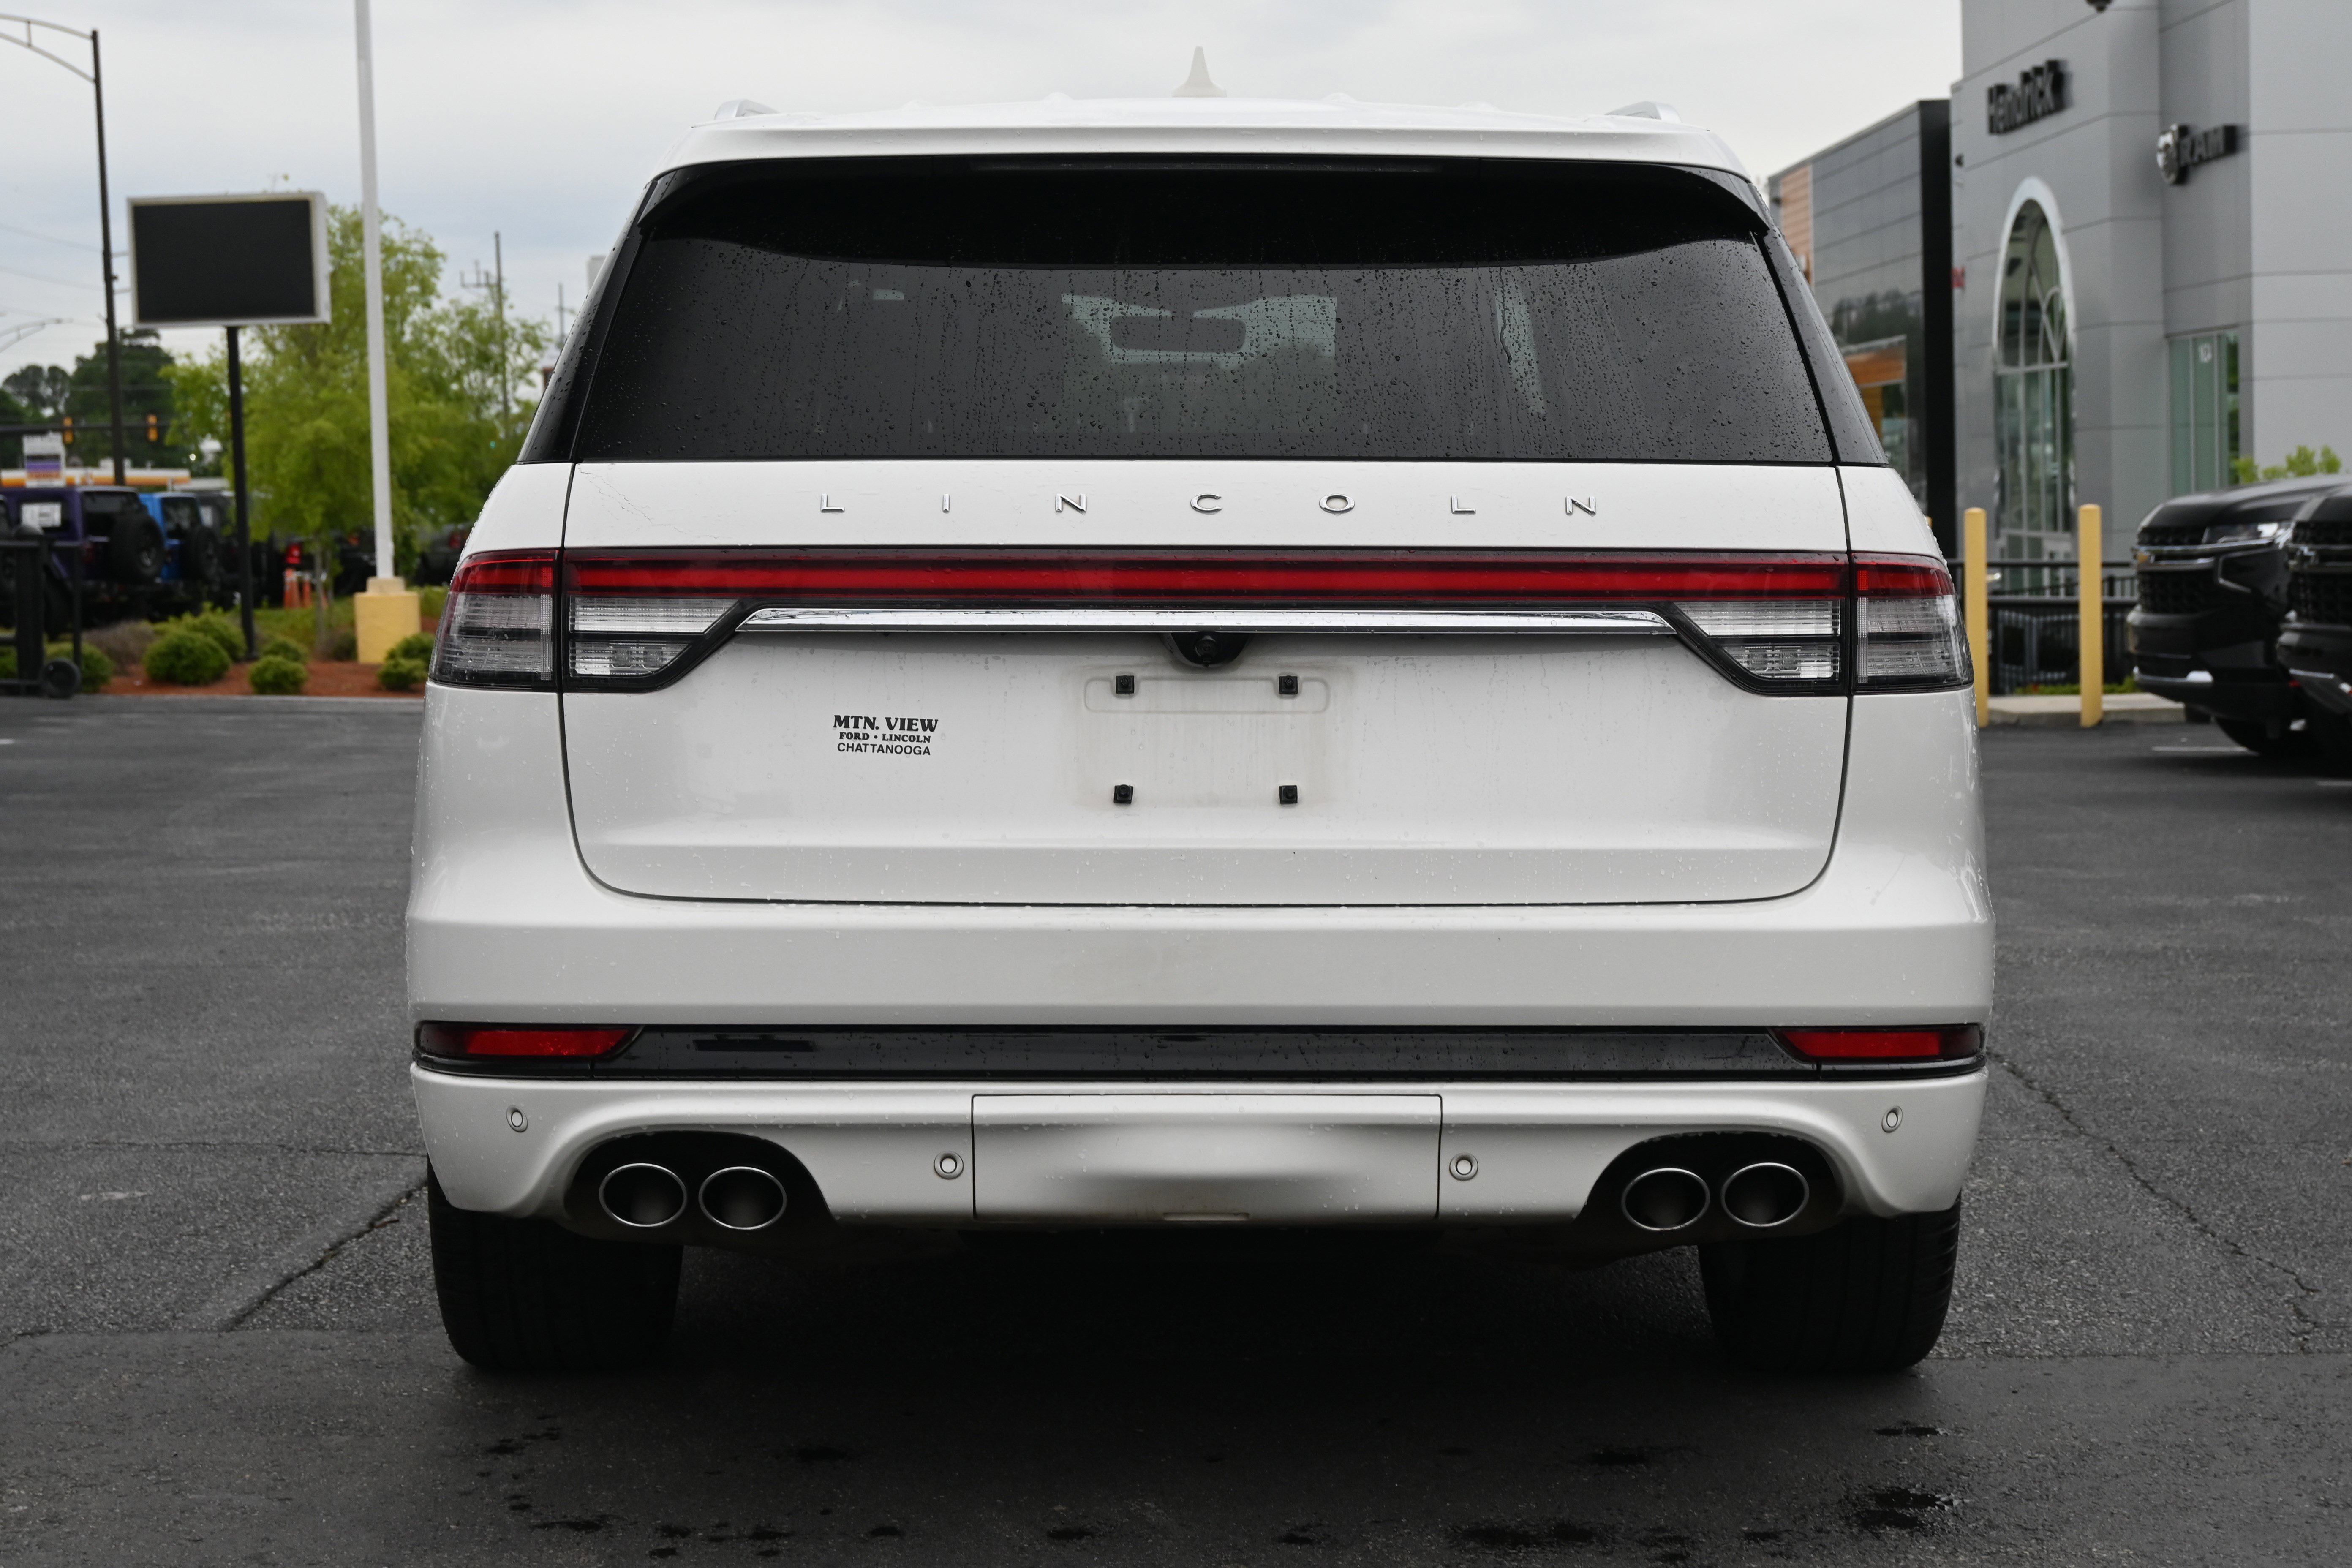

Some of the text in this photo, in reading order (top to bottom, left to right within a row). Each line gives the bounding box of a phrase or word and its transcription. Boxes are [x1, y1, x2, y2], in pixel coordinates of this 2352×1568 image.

[1988, 59, 2064, 134] Hendrick
[2179, 126, 2235, 166] RAM
[820, 493, 1596, 515] LINCOLN
[833, 714, 939, 732] MTN. VIEW
[839, 731, 931, 743] FORD LINCOLN
[837, 742, 931, 756] CHATTANOOGA
